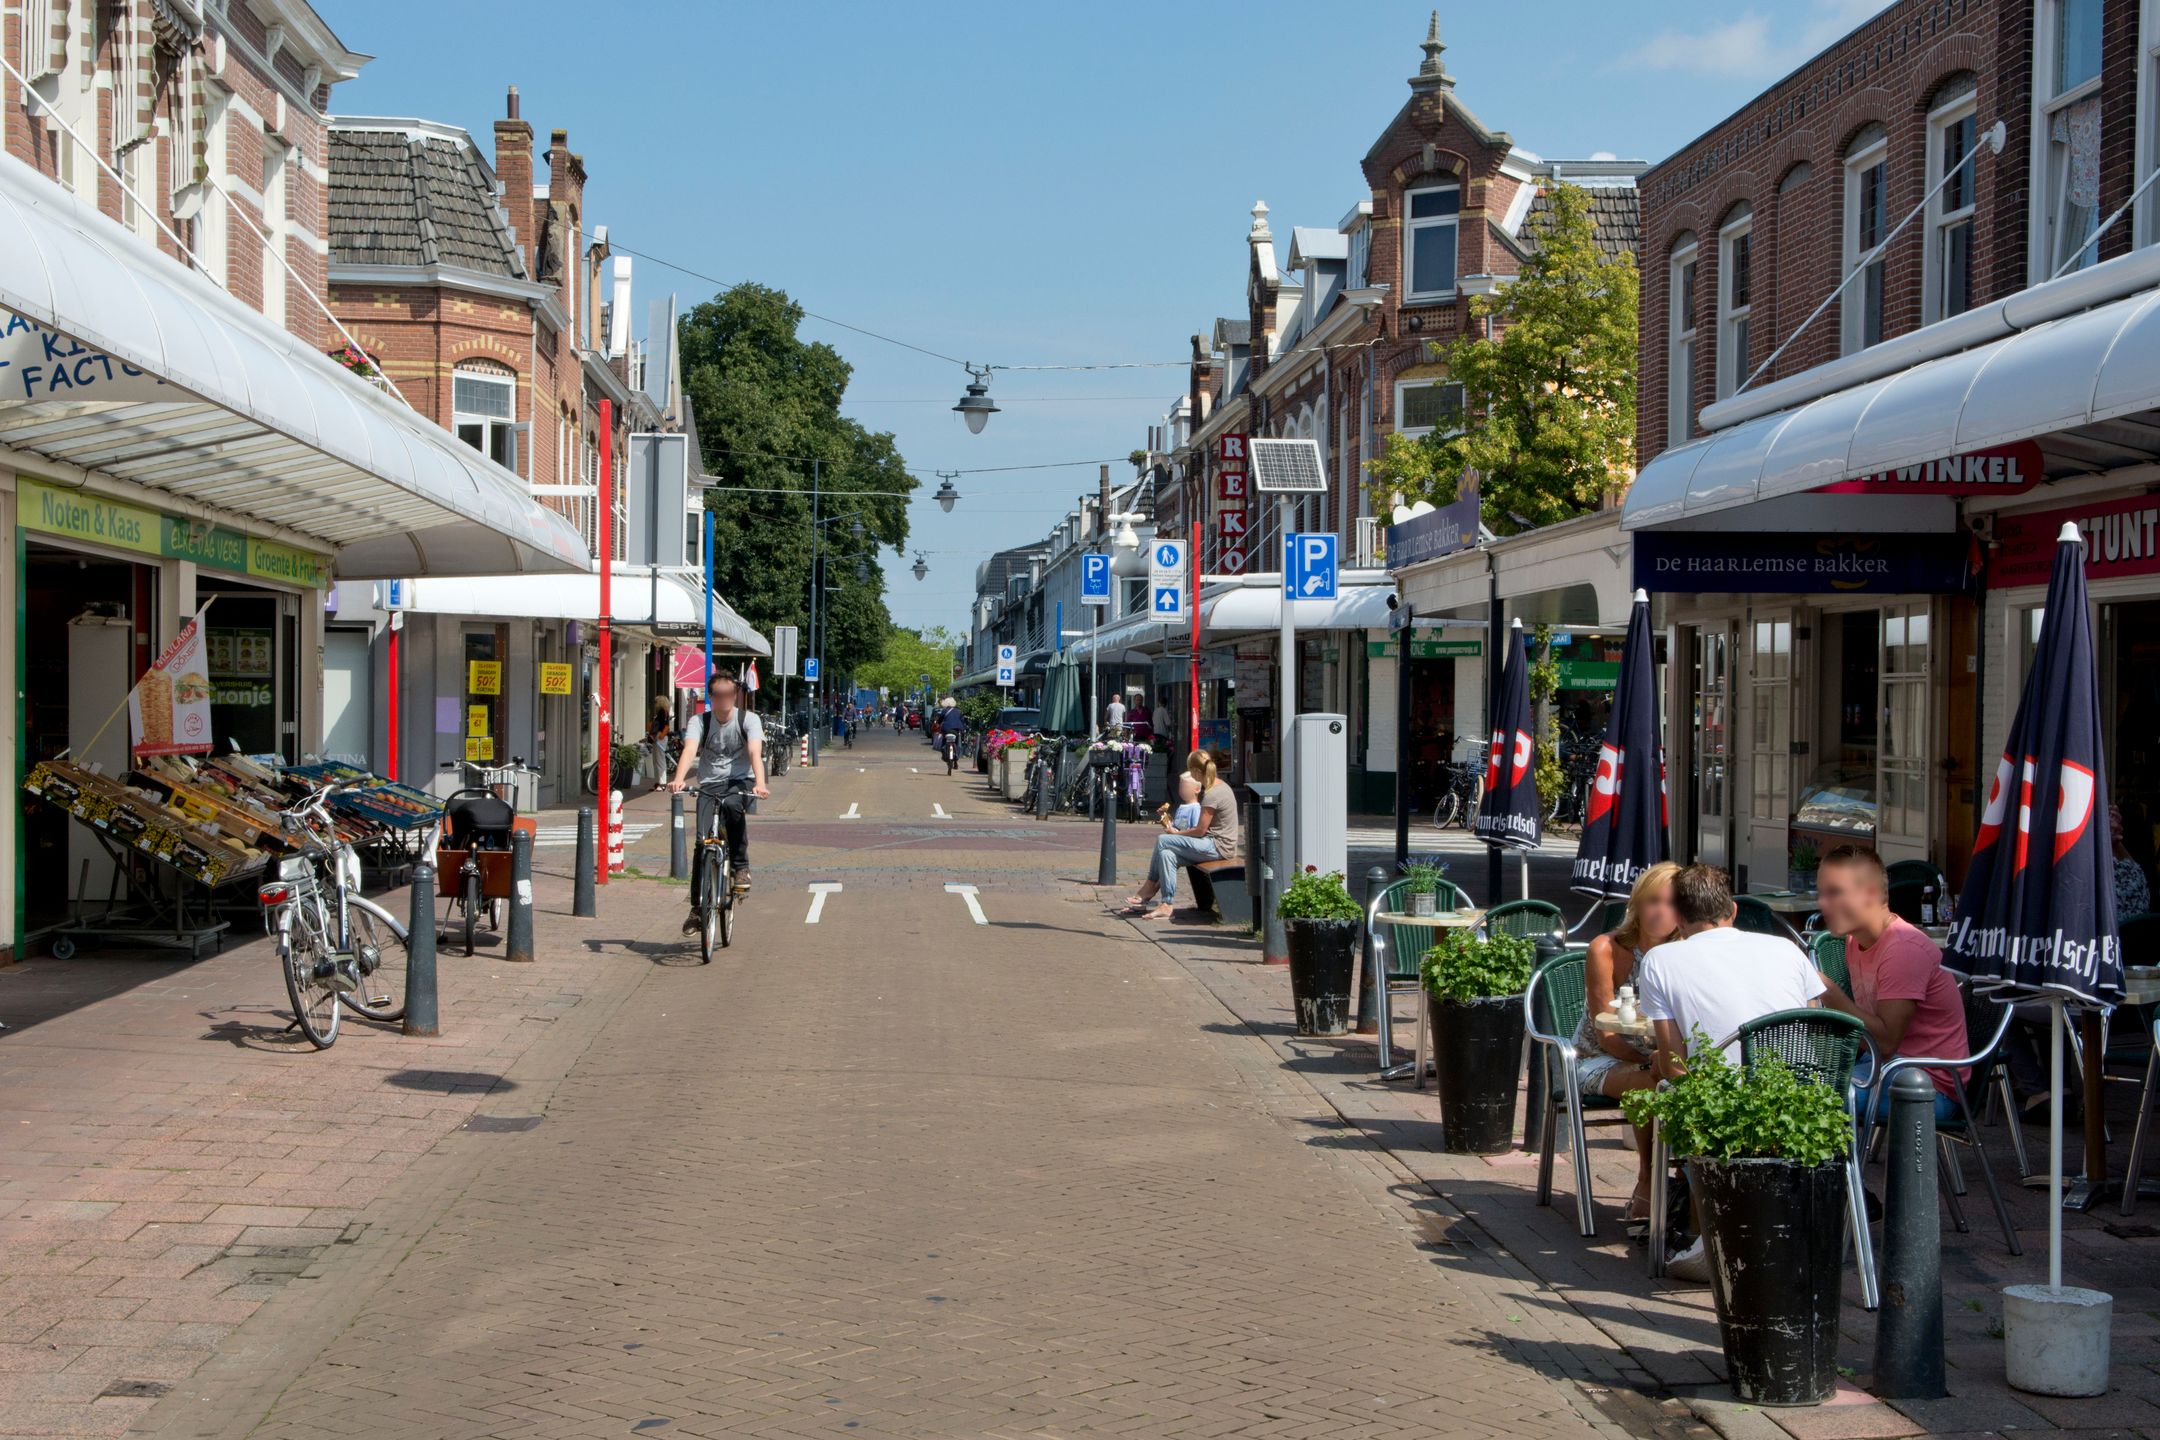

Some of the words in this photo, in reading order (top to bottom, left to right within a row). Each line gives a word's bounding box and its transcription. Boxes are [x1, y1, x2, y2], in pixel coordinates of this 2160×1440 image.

[42, 491, 90, 532] Noten
[94, 503, 104, 536] &
[108, 507, 141, 543] Kaas
[1224, 437, 1244, 571] REKO
[255, 545, 290, 576] Groente
[291, 562, 298, 578] &
[1088, 557, 1104, 579] P
[1305, 539, 1328, 572] P
[156, 624, 195, 668] MEVLANA
[476, 676, 496, 687] 50%
[545, 677, 566, 687] 50%
[807, 660, 816, 671] P
